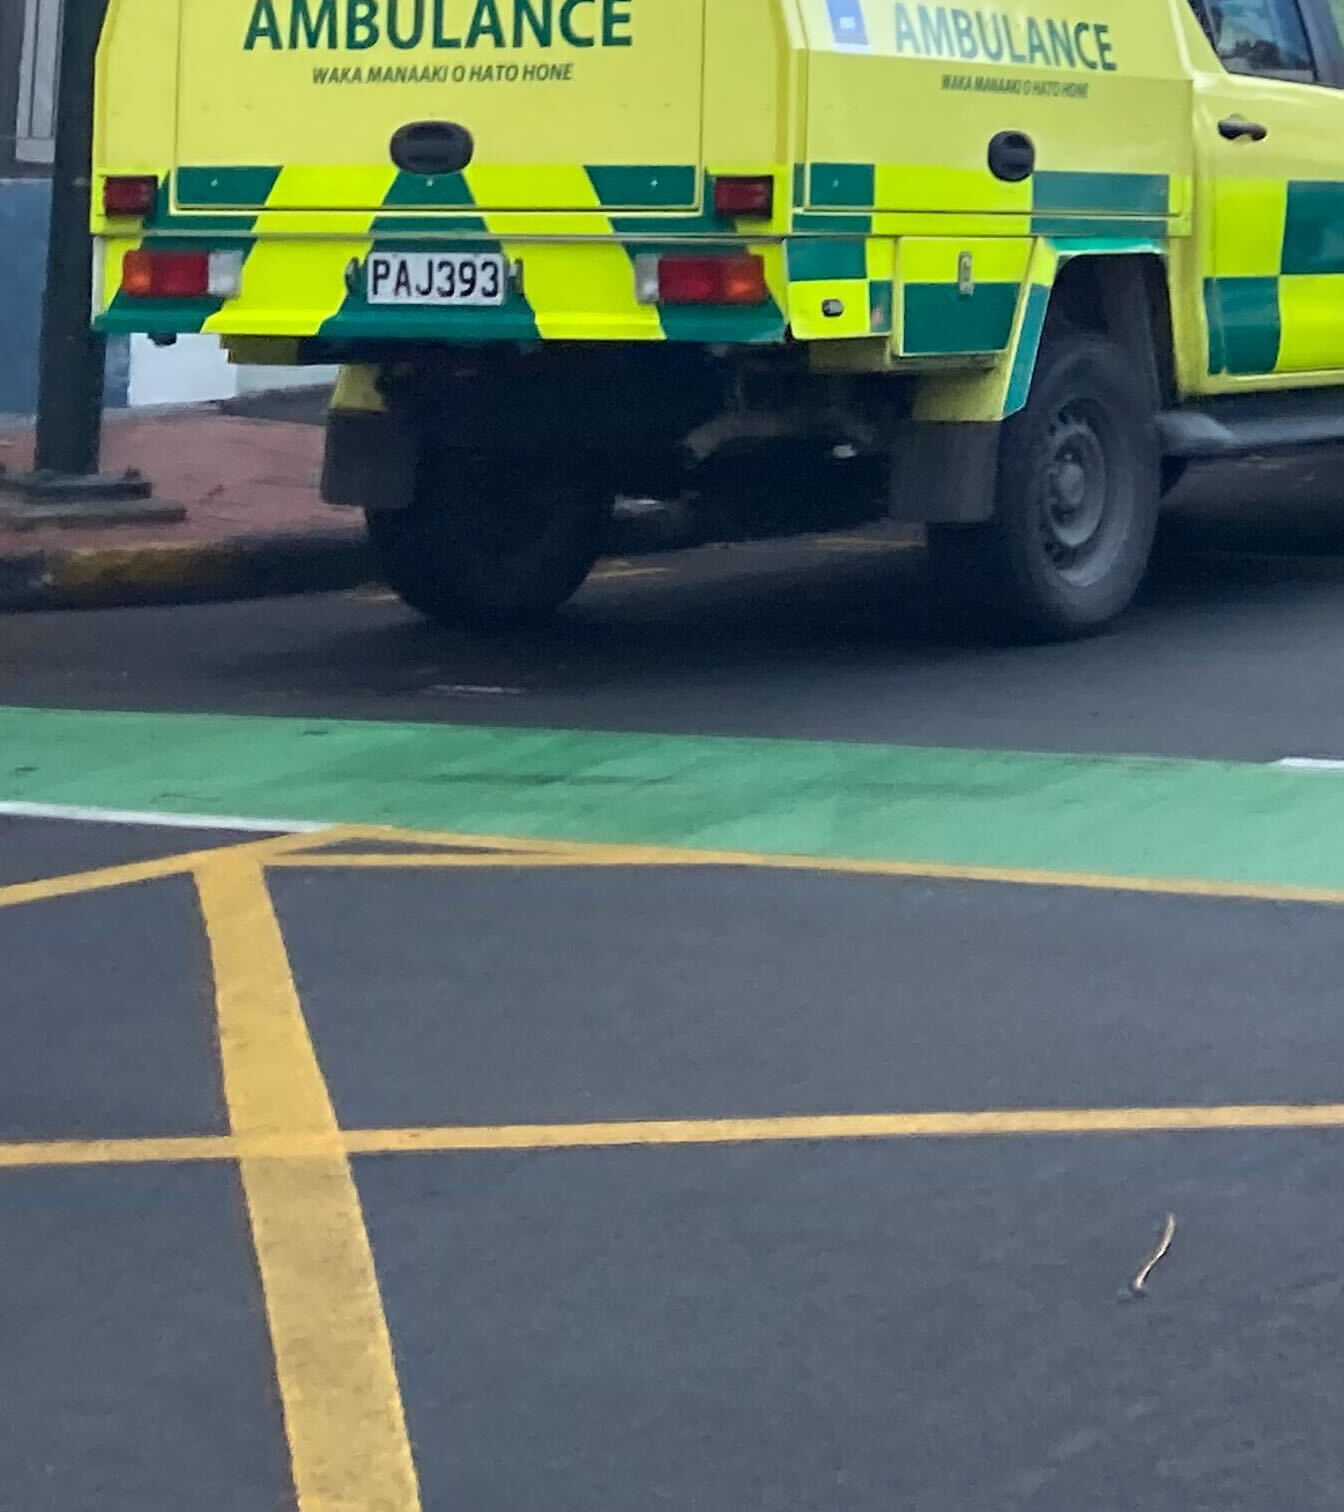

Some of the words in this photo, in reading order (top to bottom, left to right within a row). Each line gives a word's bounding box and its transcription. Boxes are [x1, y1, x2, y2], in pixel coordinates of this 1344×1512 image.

[895, 1, 1117, 71] AMBULANCE
[312, 66, 363, 85] WAKA
[366, 65, 449, 85] MANAAKI
[452, 68, 465, 82] O
[469, 65, 518, 82] HATO
[522, 63, 574, 81] HONE
[371, 258, 499, 297] PAJ393
